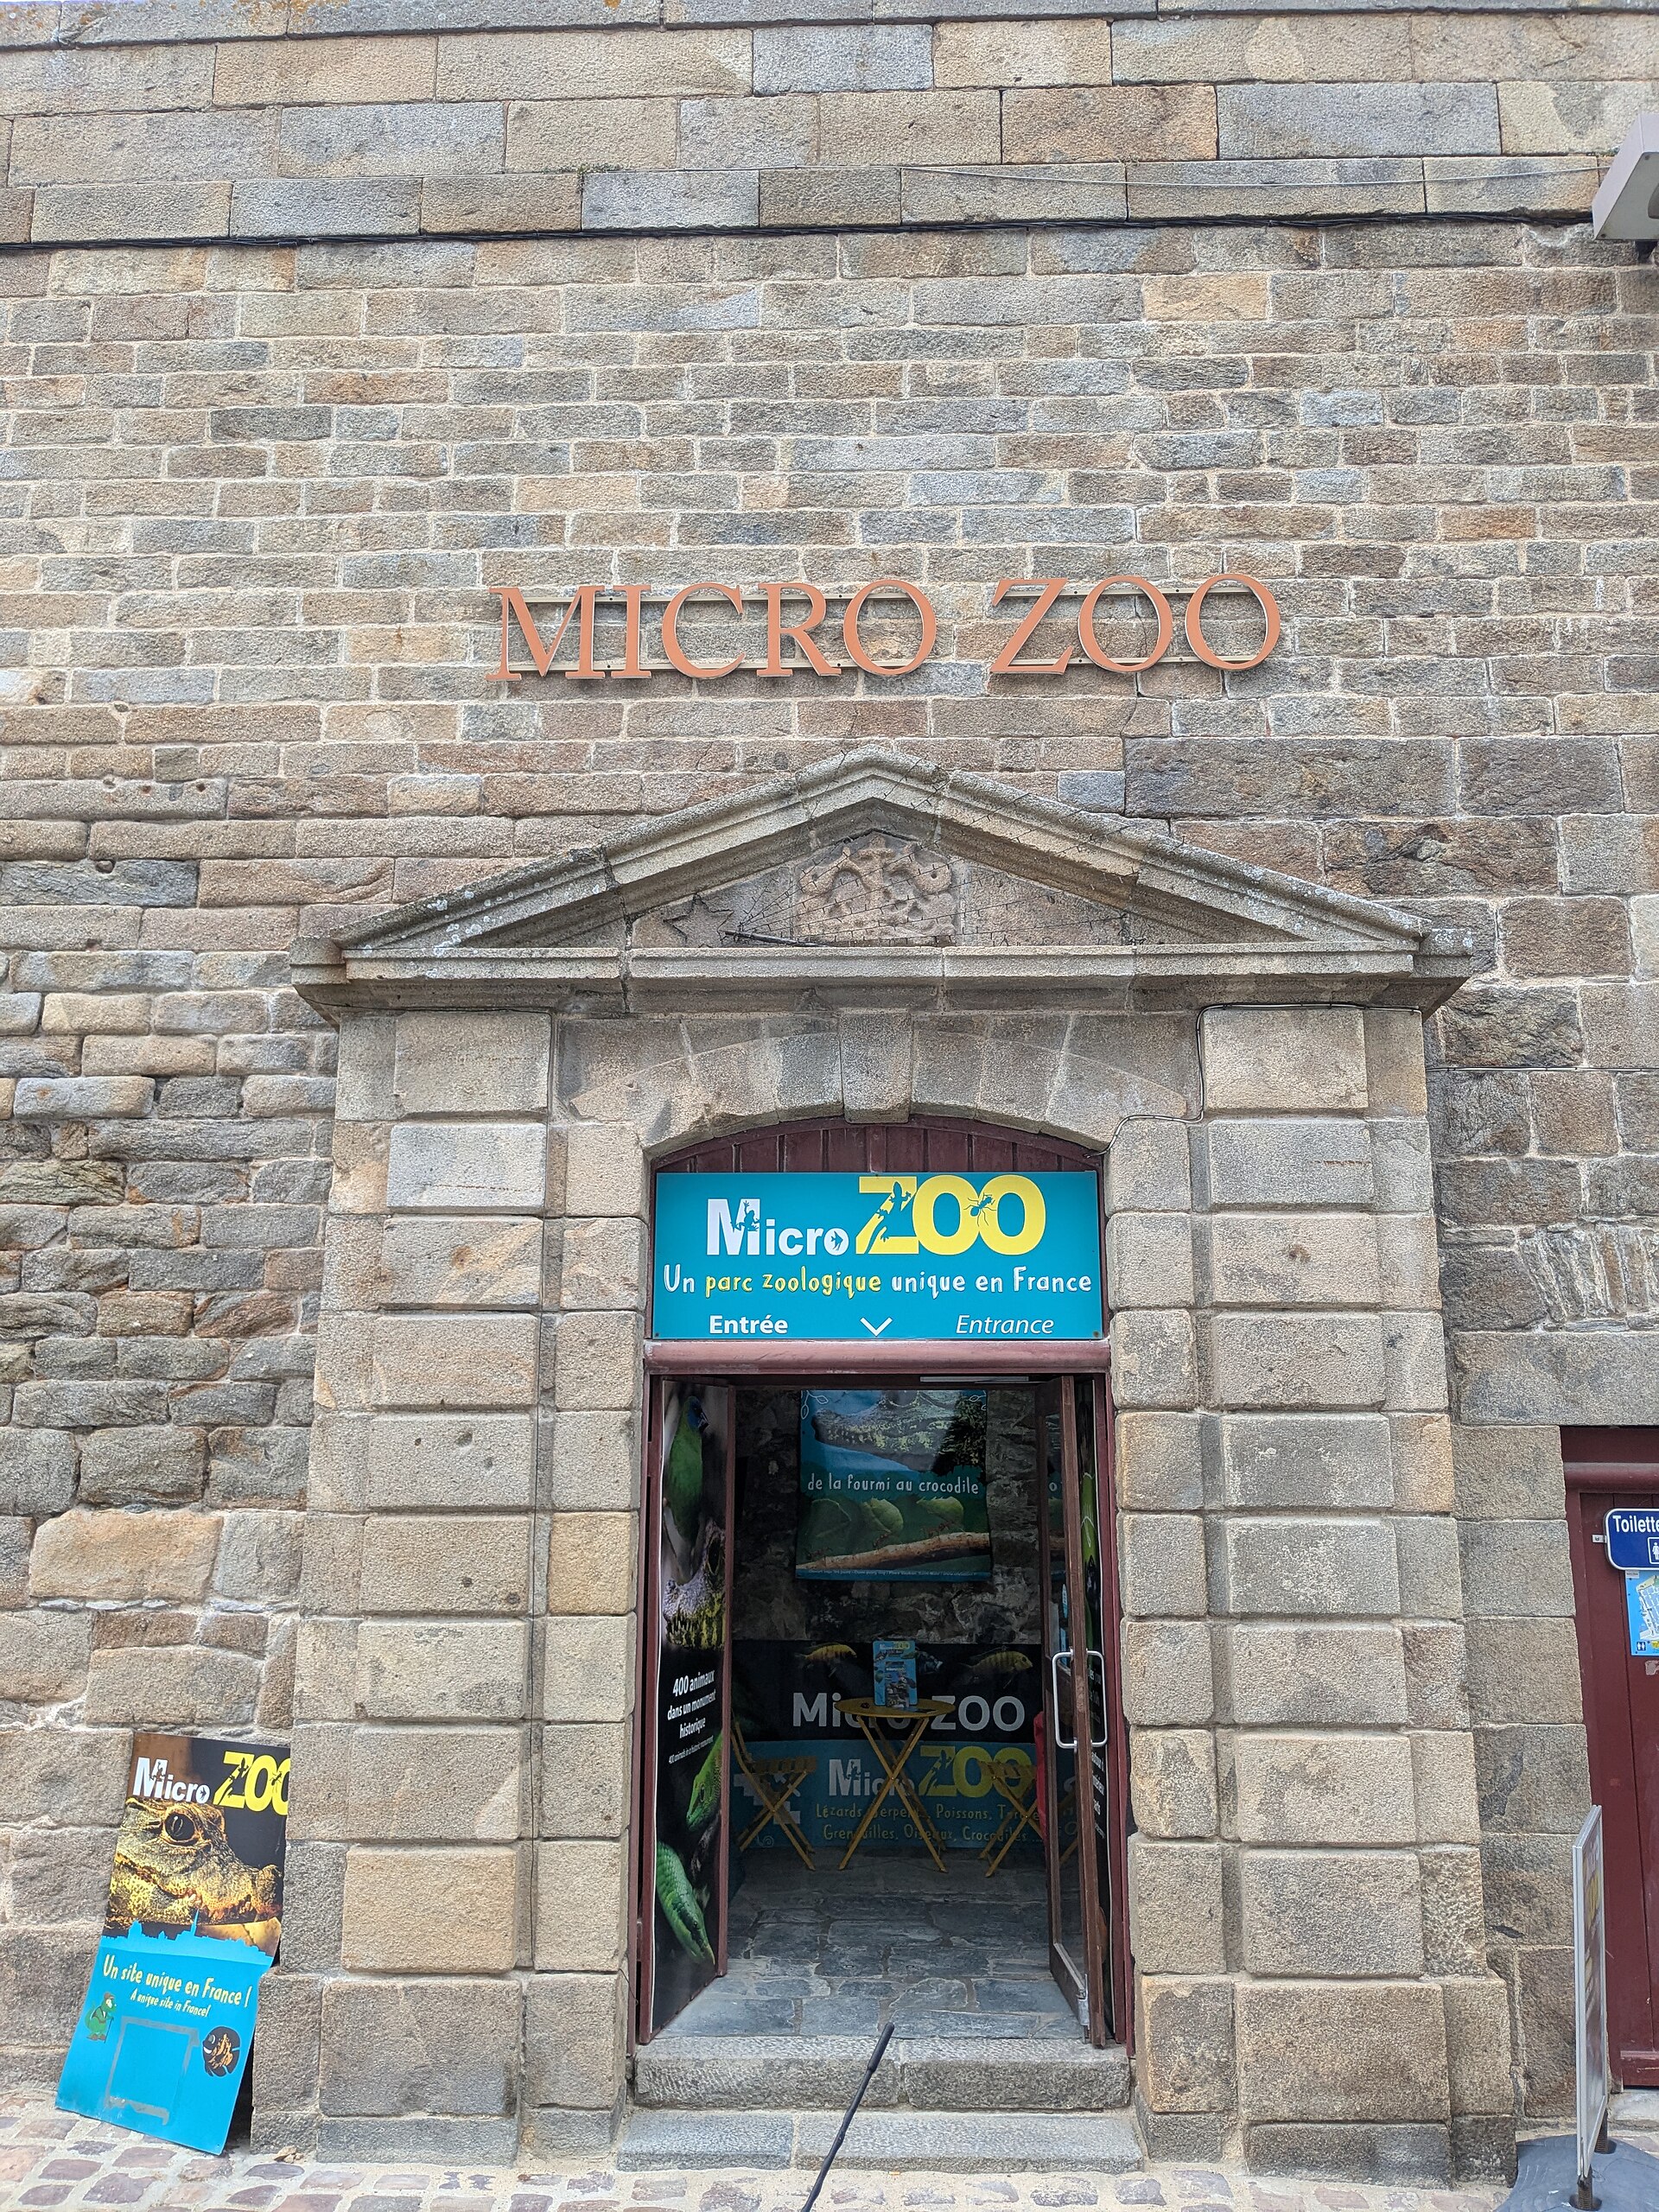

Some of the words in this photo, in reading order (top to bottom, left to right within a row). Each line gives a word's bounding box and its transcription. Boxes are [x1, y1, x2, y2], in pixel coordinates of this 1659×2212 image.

[485, 579, 937, 680] MICRO
[989, 573, 1281, 676] ZOO
[706, 1198, 849, 1255] Micro
[855, 1174, 1046, 1255] ZOO
[664, 1263, 695, 1294] Un
[705, 1274, 753, 1299] parc
[762, 1266, 881, 1300] zoologique
[891, 1268, 966, 1300] unique
[976, 1274, 1003, 1294] en
[1013, 1266, 1092, 1294] France
[709, 1313, 788, 1334] Entrée
[956, 1314, 1054, 1335] Entrance
[808, 1472, 823, 1491] de
[829, 1472, 842, 1490] la
[848, 1473, 890, 1491] fourmi
[896, 1479, 912, 1491] au
[918, 1476, 979, 1495] crocodile
[672, 1675, 690, 1697] 400
[690, 1669, 715, 1693] animaux
[667, 1705, 683, 1721] dans
[683, 1701, 691, 1714] un
[691, 1688, 716, 1712] monument
[930, 1695, 1026, 1732] ZOO
[679, 1717, 706, 1738] historique
[132, 1757, 210, 1804] Micro
[918, 1746, 1032, 1798] ZOO
[103, 1954, 118, 1980] Un
[120, 1962, 143, 1984] site
[146, 1972, 182, 1995] unique
[185, 1980, 200, 1998] en
[202, 1977, 242, 2005] France
[130, 1988, 138, 2001] A
[137, 1991, 159, 2007] unique
[160, 1996, 174, 2010] site
[174, 2000, 181, 2012] in
[182, 2000, 212, 2018] France!
